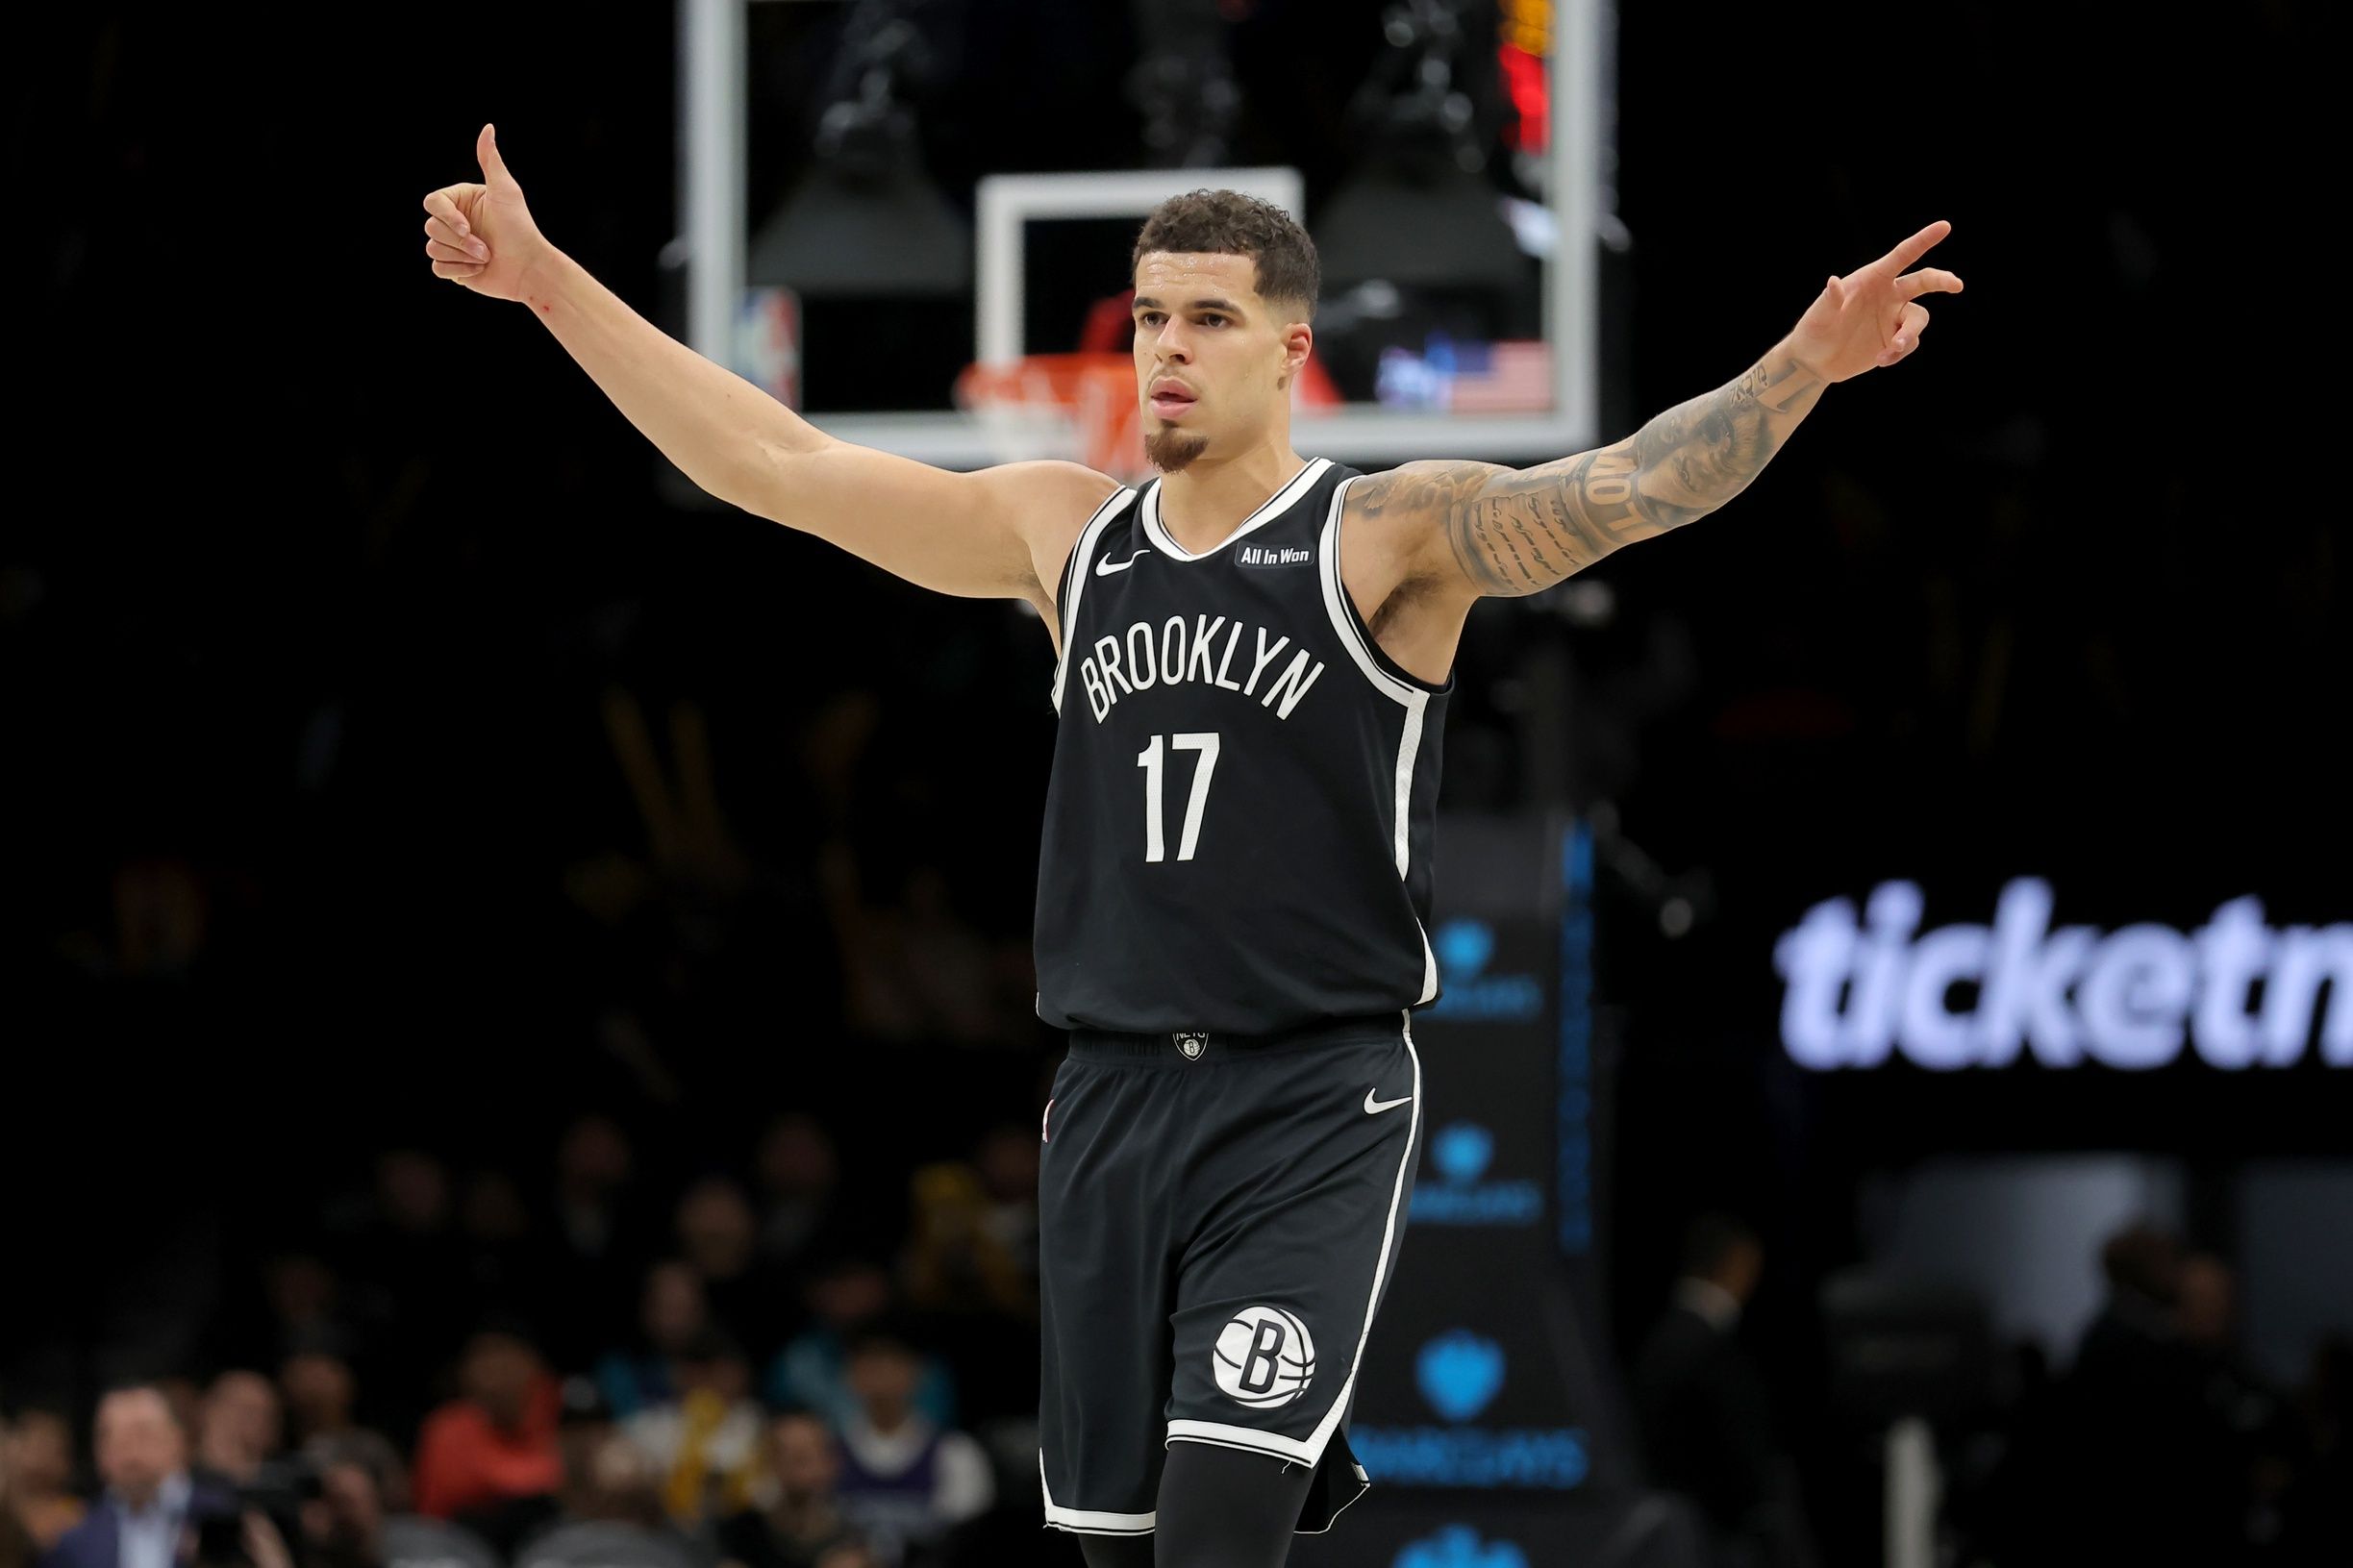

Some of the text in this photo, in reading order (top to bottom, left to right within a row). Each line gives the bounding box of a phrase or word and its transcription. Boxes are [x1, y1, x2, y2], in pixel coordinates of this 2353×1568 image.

[1240, 546, 1310, 565] All In Won
[1080, 613, 1325, 724] BROOKLYN
[1137, 732, 1220, 862] 17
[1239, 1318, 1286, 1394] B
